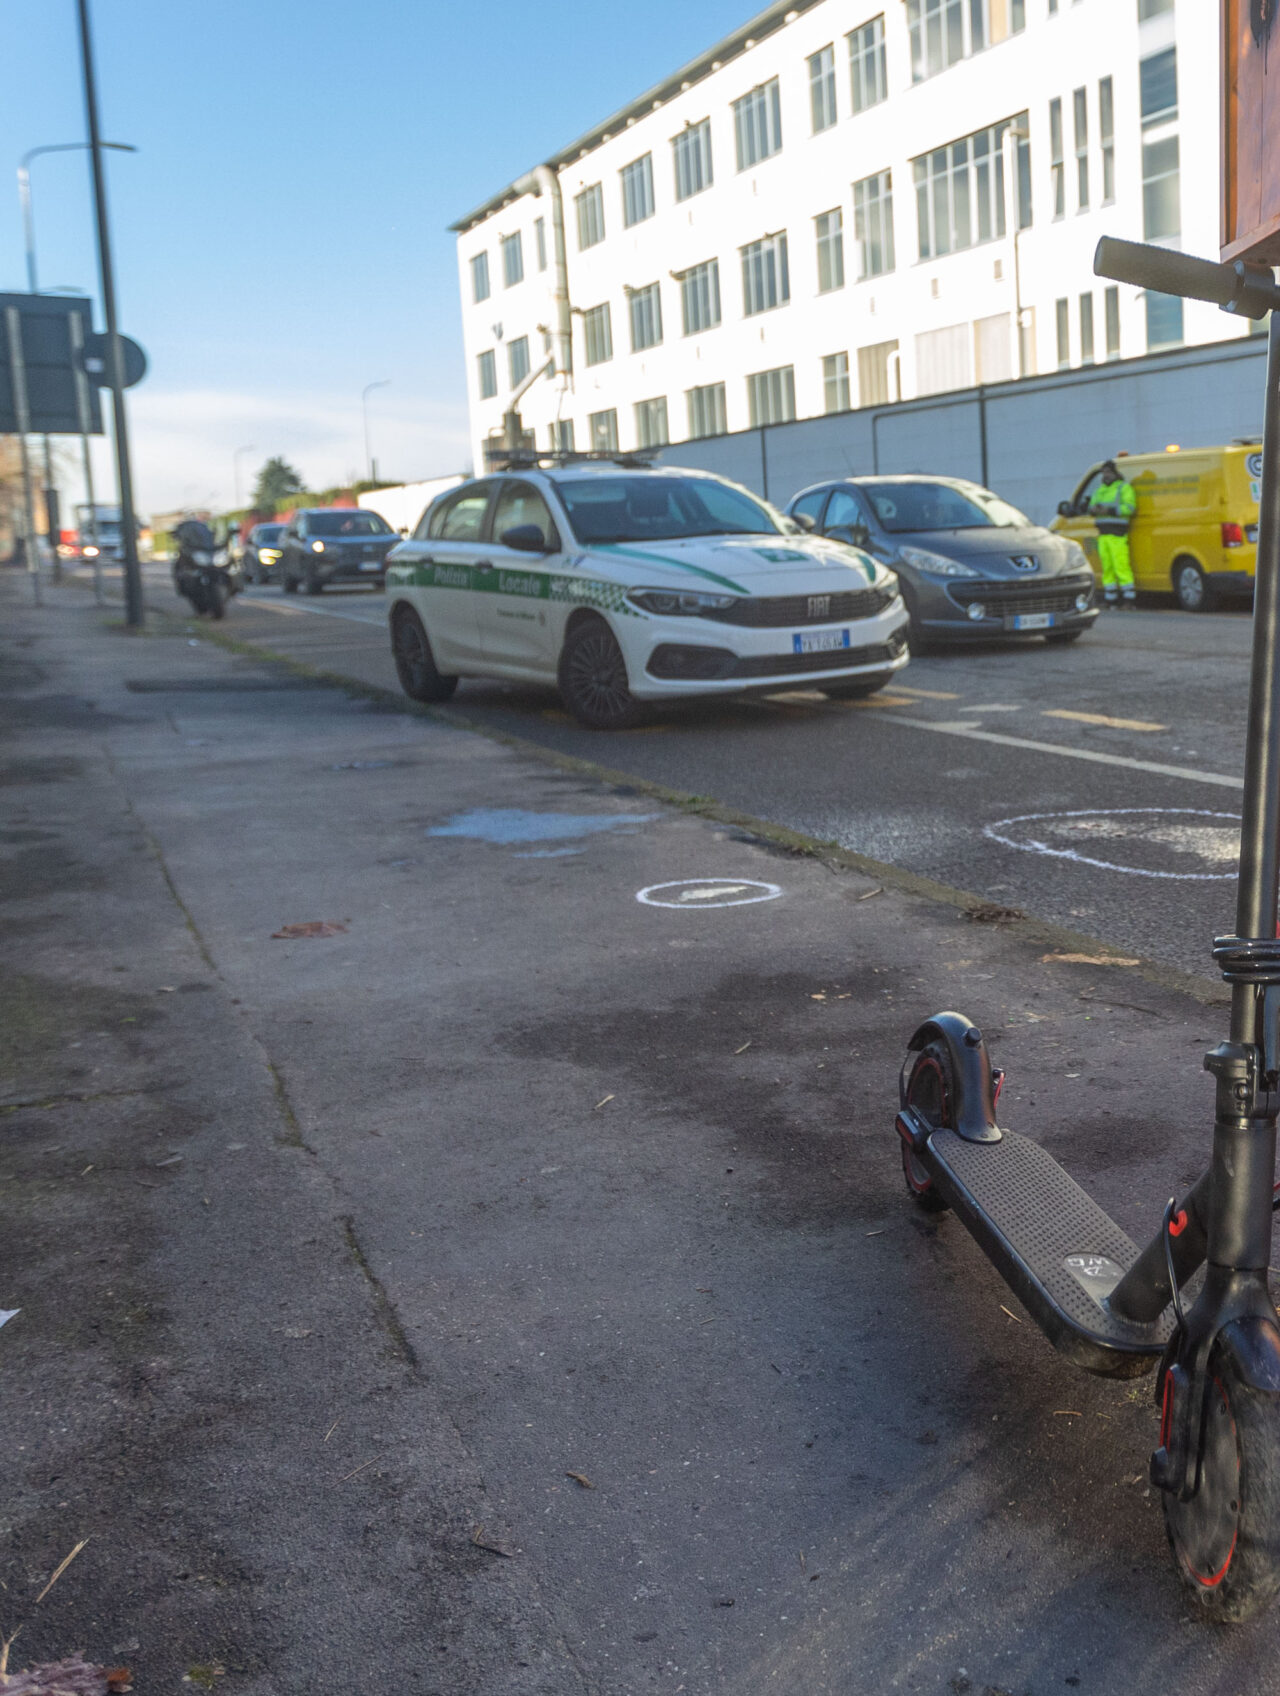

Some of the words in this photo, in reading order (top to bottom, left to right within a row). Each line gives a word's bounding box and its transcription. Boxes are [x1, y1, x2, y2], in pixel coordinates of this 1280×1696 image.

[434, 566, 468, 585] Polizia
[498, 570, 541, 595] Locale
[807, 595, 831, 617] FIAT
